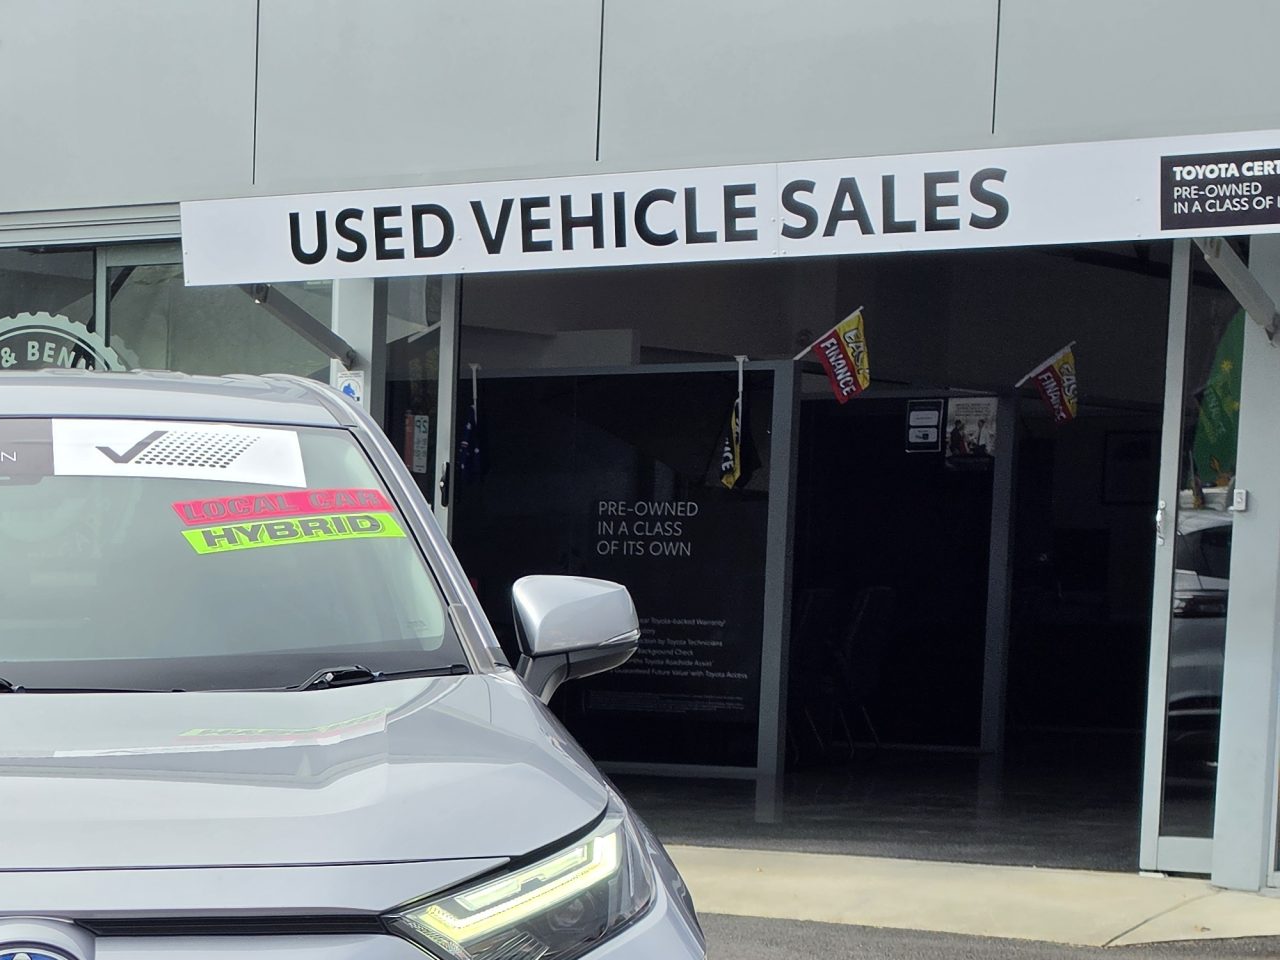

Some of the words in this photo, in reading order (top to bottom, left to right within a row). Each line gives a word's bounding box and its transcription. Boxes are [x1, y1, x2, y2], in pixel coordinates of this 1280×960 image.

[1172, 162, 1240, 181] TOYOTA
[1173, 182, 1262, 200] PRE-OWNED
[1173, 201, 1189, 214] IN
[1191, 200, 1203, 213] A
[1205, 197, 1250, 213] CLASS
[1252, 195, 1274, 210] OF
[288, 203, 456, 265] USED
[469, 183, 758, 255] VEHICLE
[779, 167, 1010, 240] SALES
[0, 346, 18, 368] &
[820, 337, 857, 396] FINANCE
[183, 494, 297, 521] LOCAL
[310, 488, 381, 510] CAR
[598, 500, 699, 517] PRE-OWNED
[200, 514, 387, 549] HYBRID
[597, 520, 614, 536] IN
[617, 520, 629, 536] A
[633, 521, 683, 537] CLASS
[596, 540, 620, 555] OF
[623, 541, 645, 556] ITS
[649, 541, 691, 557] OWN
